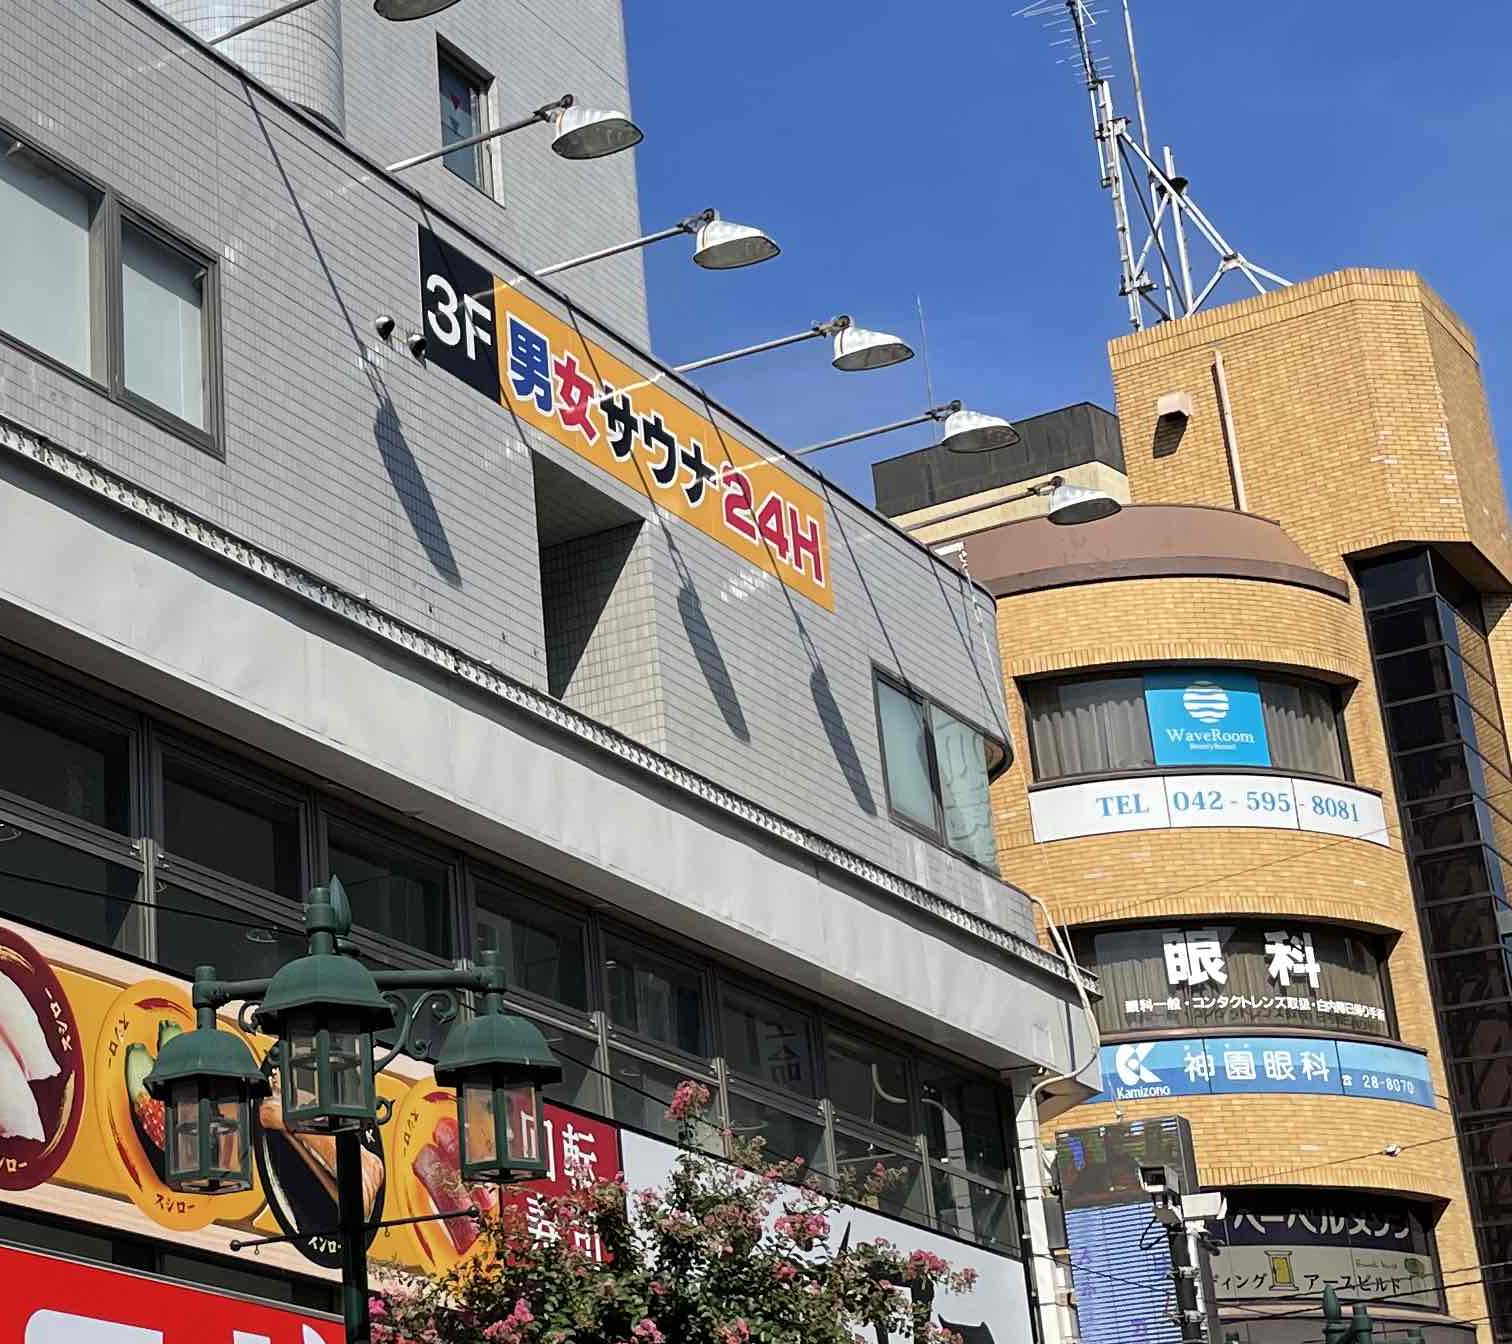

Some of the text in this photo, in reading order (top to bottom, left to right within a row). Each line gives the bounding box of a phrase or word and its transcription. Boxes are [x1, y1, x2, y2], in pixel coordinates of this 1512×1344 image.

[426, 273, 492, 361] 3F
[506, 311, 826, 589] 男女サウナ 24H
[1166, 726, 1256, 746] WaveRoom
[1096, 791, 1151, 818] TEL
[1161, 928, 1321, 990] 眼科
[45, 987, 73, 1053] スシロー
[1183, 1047, 1332, 1083] 神園眼科
[1115, 1086, 1172, 1100] Kamizono
[154, 1193, 195, 1214] スシロー
[1212, 1273, 1268, 1292] ィング
